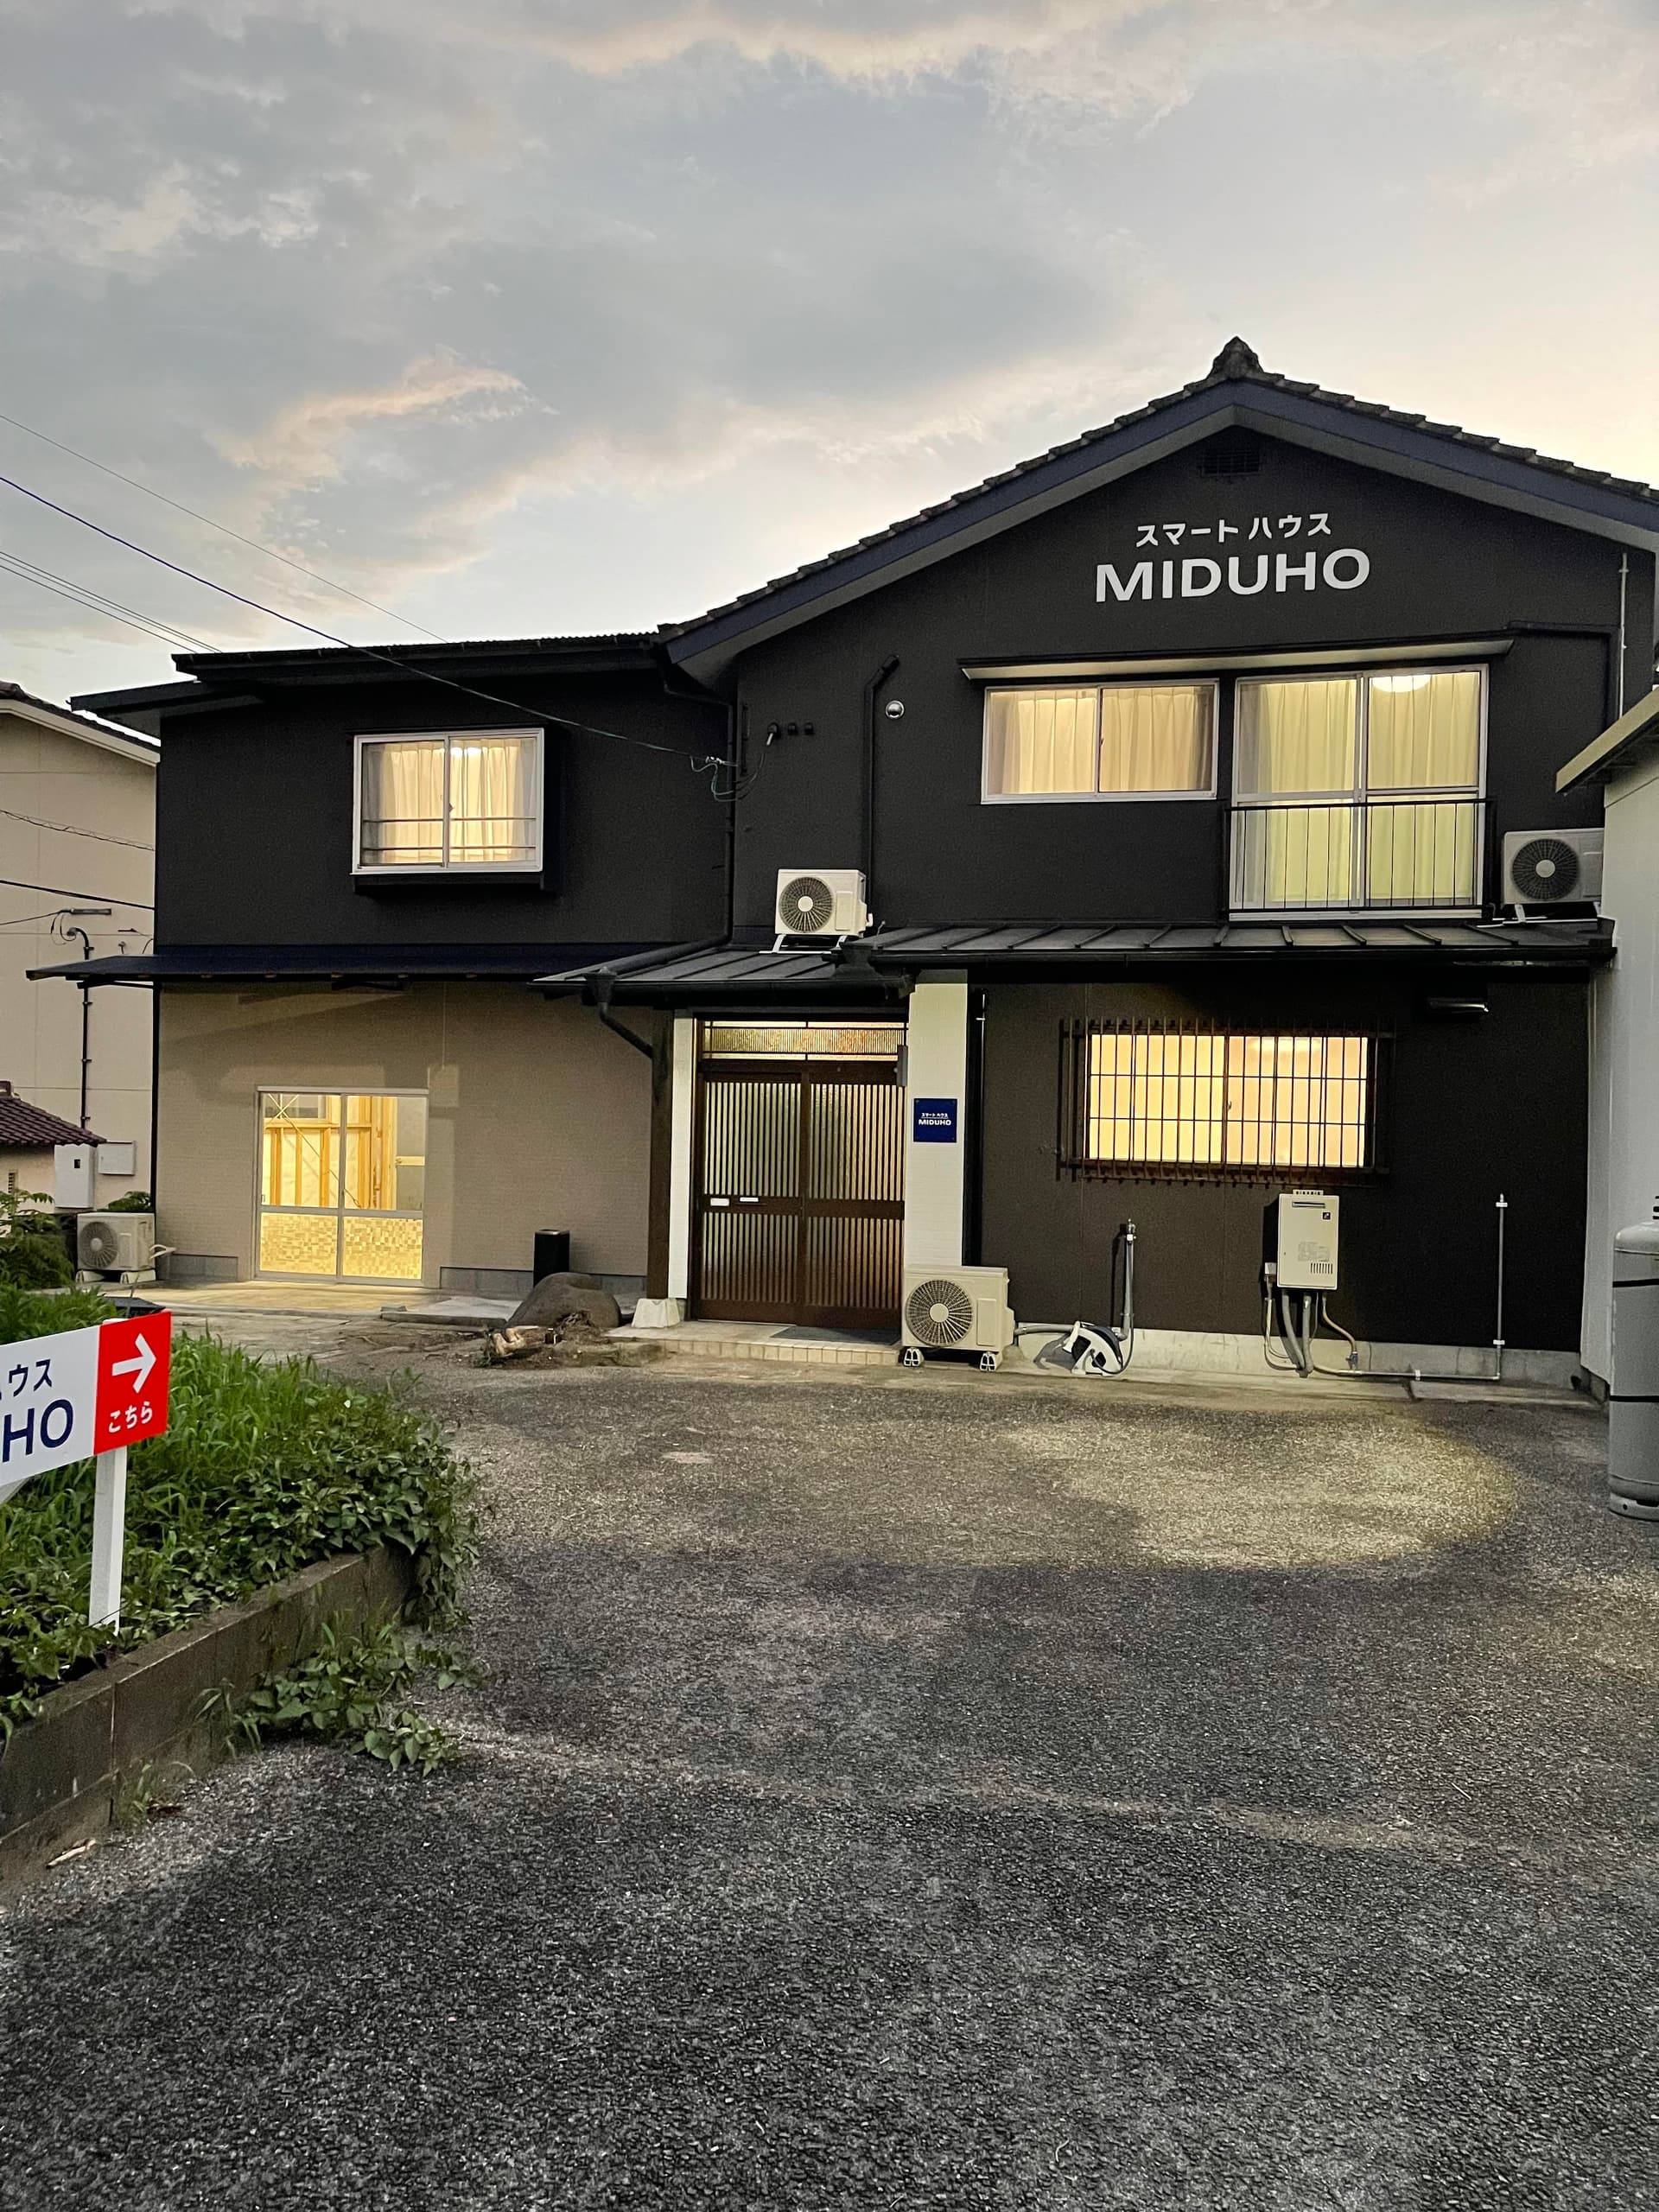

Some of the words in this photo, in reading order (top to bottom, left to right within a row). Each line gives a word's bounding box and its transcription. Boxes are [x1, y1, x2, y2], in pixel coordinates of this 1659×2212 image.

[1135, 519, 1239, 548] スマート
[1248, 513, 1332, 541] ハウス
[1096, 548, 1370, 603] MIDUHO
[0, 1358, 53, 1400] ウス
[108, 1401, 153, 1433] こちら
